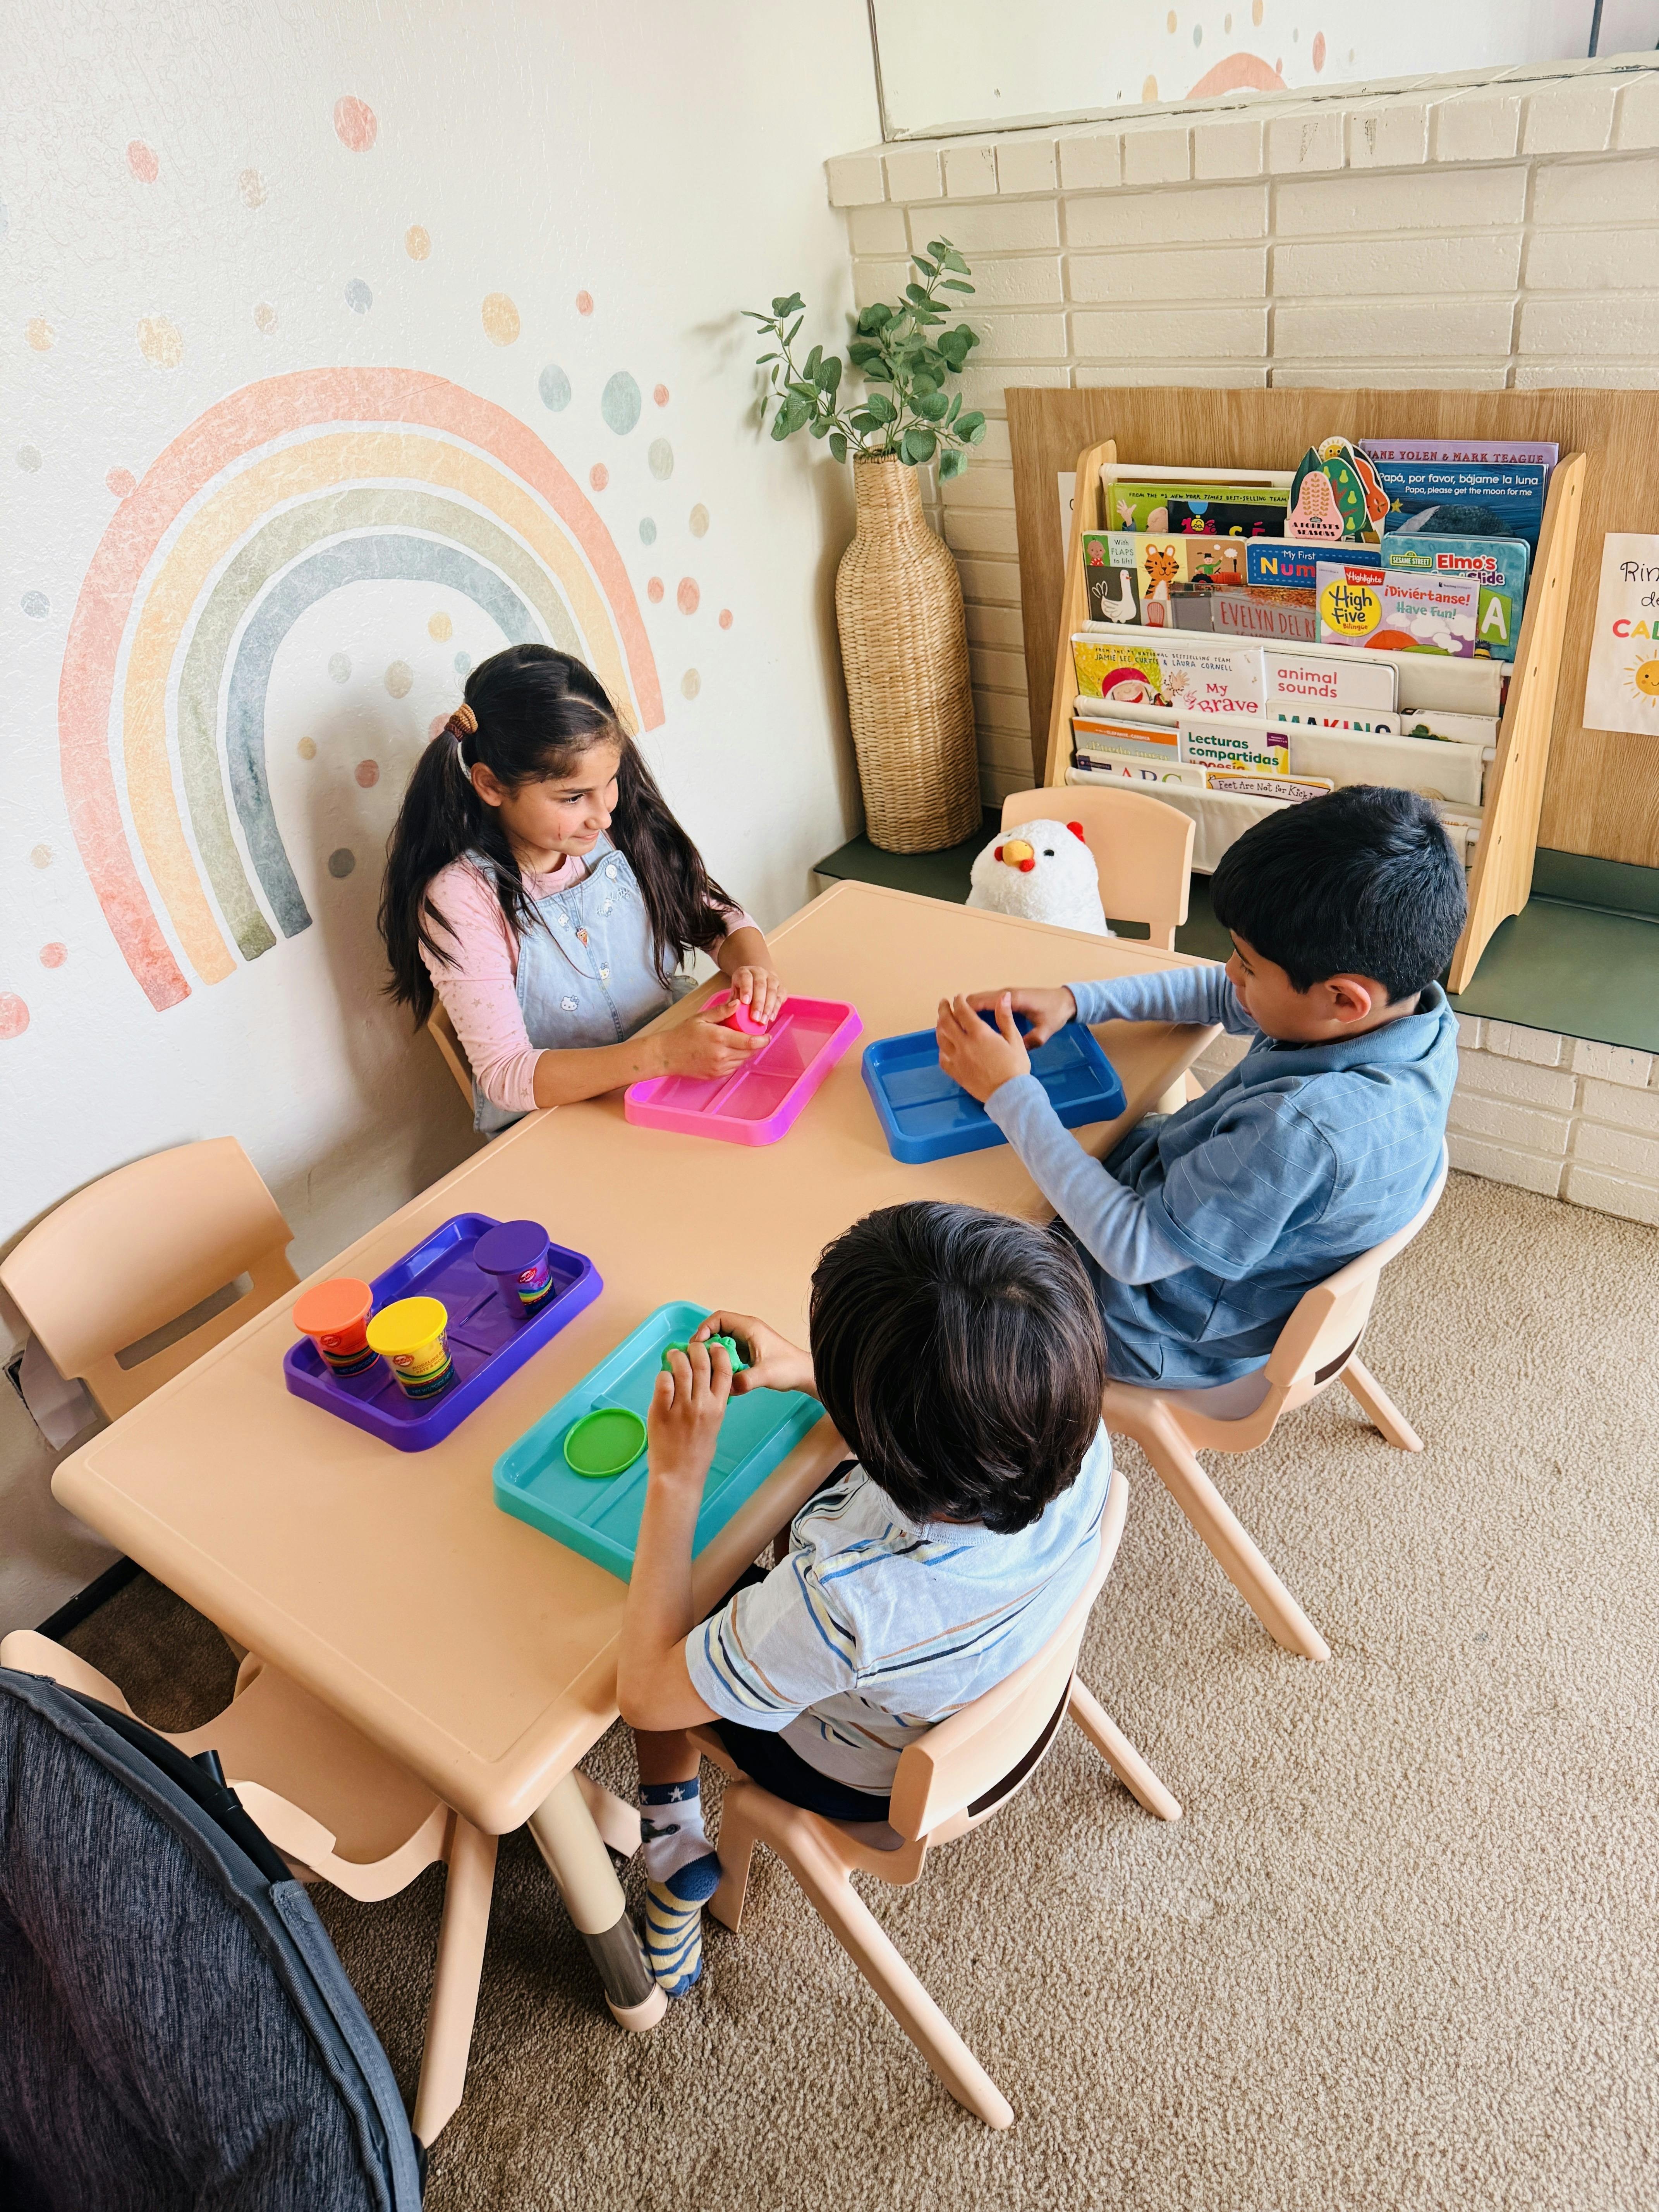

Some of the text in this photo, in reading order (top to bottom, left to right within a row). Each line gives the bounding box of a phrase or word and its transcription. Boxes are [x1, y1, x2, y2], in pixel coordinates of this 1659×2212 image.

[1367, 450, 1395, 459] JANE
[1400, 451, 1437, 460] YOLEN
[1453, 452, 1488, 462] MARK
[1493, 453, 1544, 464] TEAGUE
[1379, 473, 1538, 486] Papá, por favor, bájame la luna
[1405, 486, 1427, 494] Papa,
[1427, 487, 1453, 495] please
[1283, 551, 1316, 560] My First
[1437, 554, 1496, 570] Elmo's
[1346, 571, 1382, 584] Highlights
[1329, 586, 1372, 611] High
[1384, 585, 1471, 606] ¡Diviértanse!
[1331, 608, 1366, 624] Five
[1396, 601, 1456, 619] Have Fun!
[1481, 597, 1507, 639] A
[1221, 601, 1274, 632] EVELYN
[1279, 613, 1301, 636] DEL
[1201, 663, 1232, 671] CORNELL
[1278, 668, 1337, 684] animal
[1206, 684, 1228, 696] My
[1278, 682, 1337, 698] sounds
[1198, 698, 1258, 713] Brave
[1188, 732, 1249, 749] Lecturas
[1189, 747, 1279, 766] compartidas
[1218, 780, 1238, 790] Feet
[1239, 781, 1254, 790] Are
[1257, 783, 1273, 792] Not
[1275, 784, 1286, 793] for
